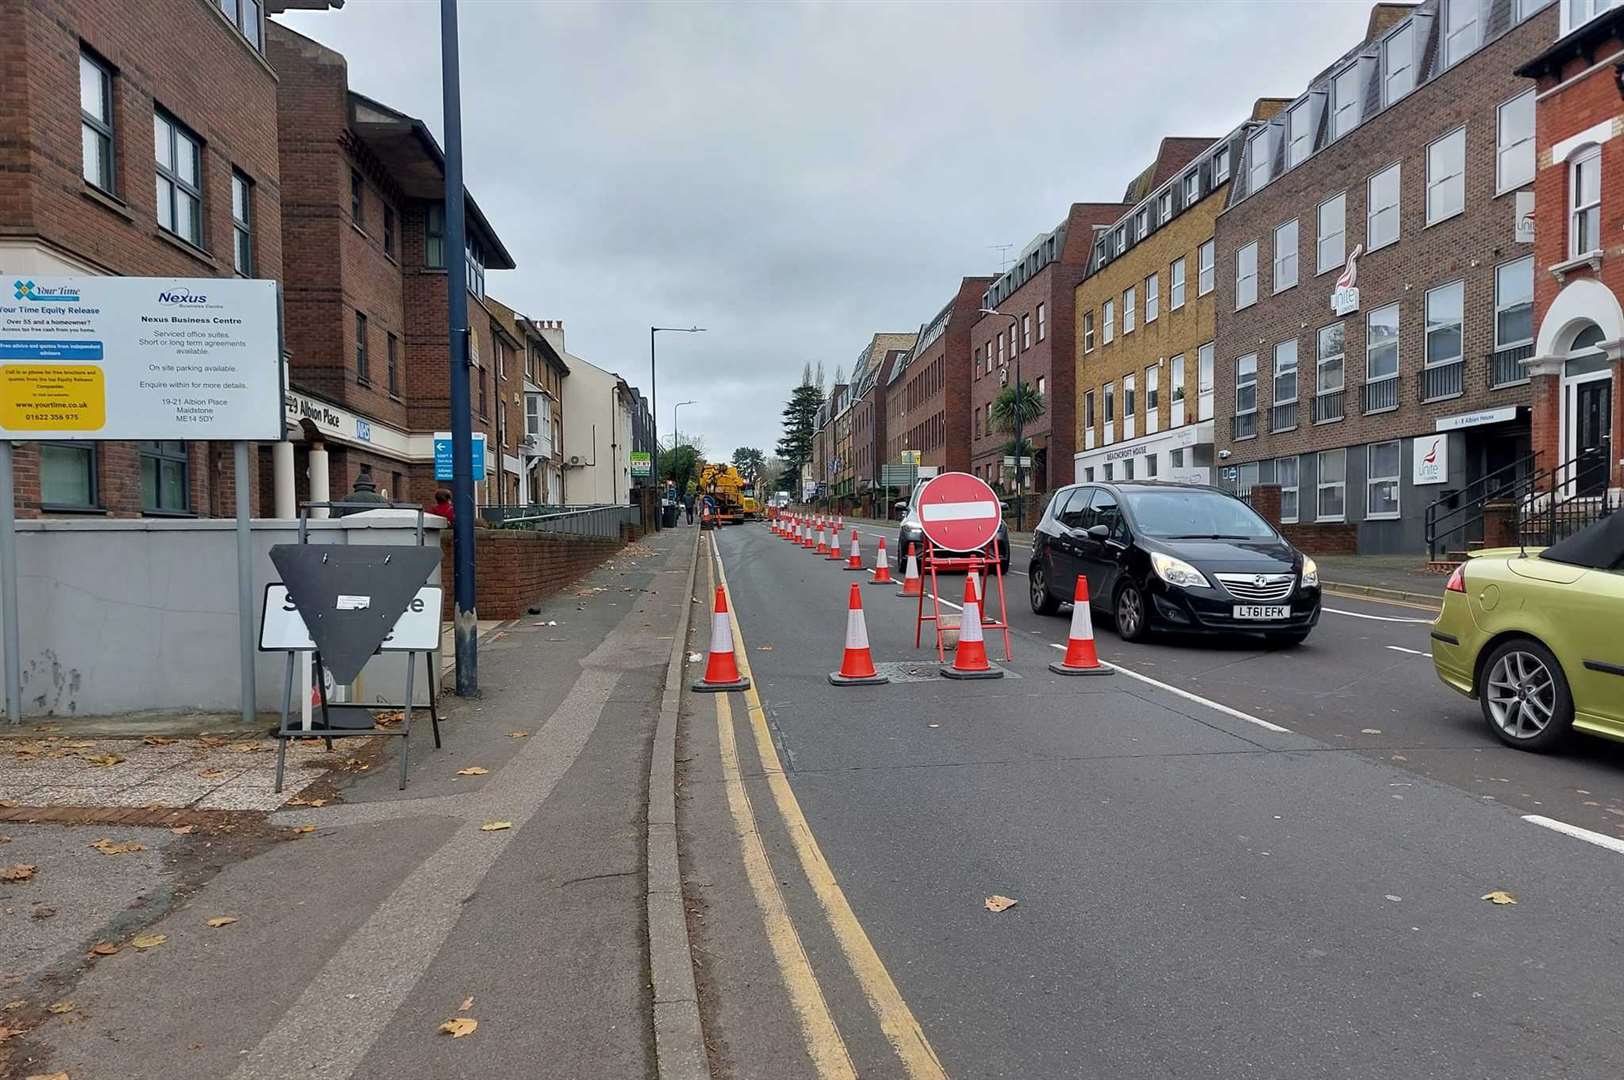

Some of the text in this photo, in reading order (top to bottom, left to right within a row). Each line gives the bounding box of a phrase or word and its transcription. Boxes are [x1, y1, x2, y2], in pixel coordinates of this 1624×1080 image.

[37, 286, 80, 295] Your Time
[158, 292, 207, 303] Nexus
[41, 307, 65, 315] Equity
[170, 339, 184, 347] long
[204, 340, 246, 348] agreements
[140, 381, 167, 389] Enquire
[300, 400, 322, 422] Albion
[323, 408, 340, 428] Place
[357, 420, 370, 441] NHS
[1239, 607, 1284, 617] LT61 EFK
